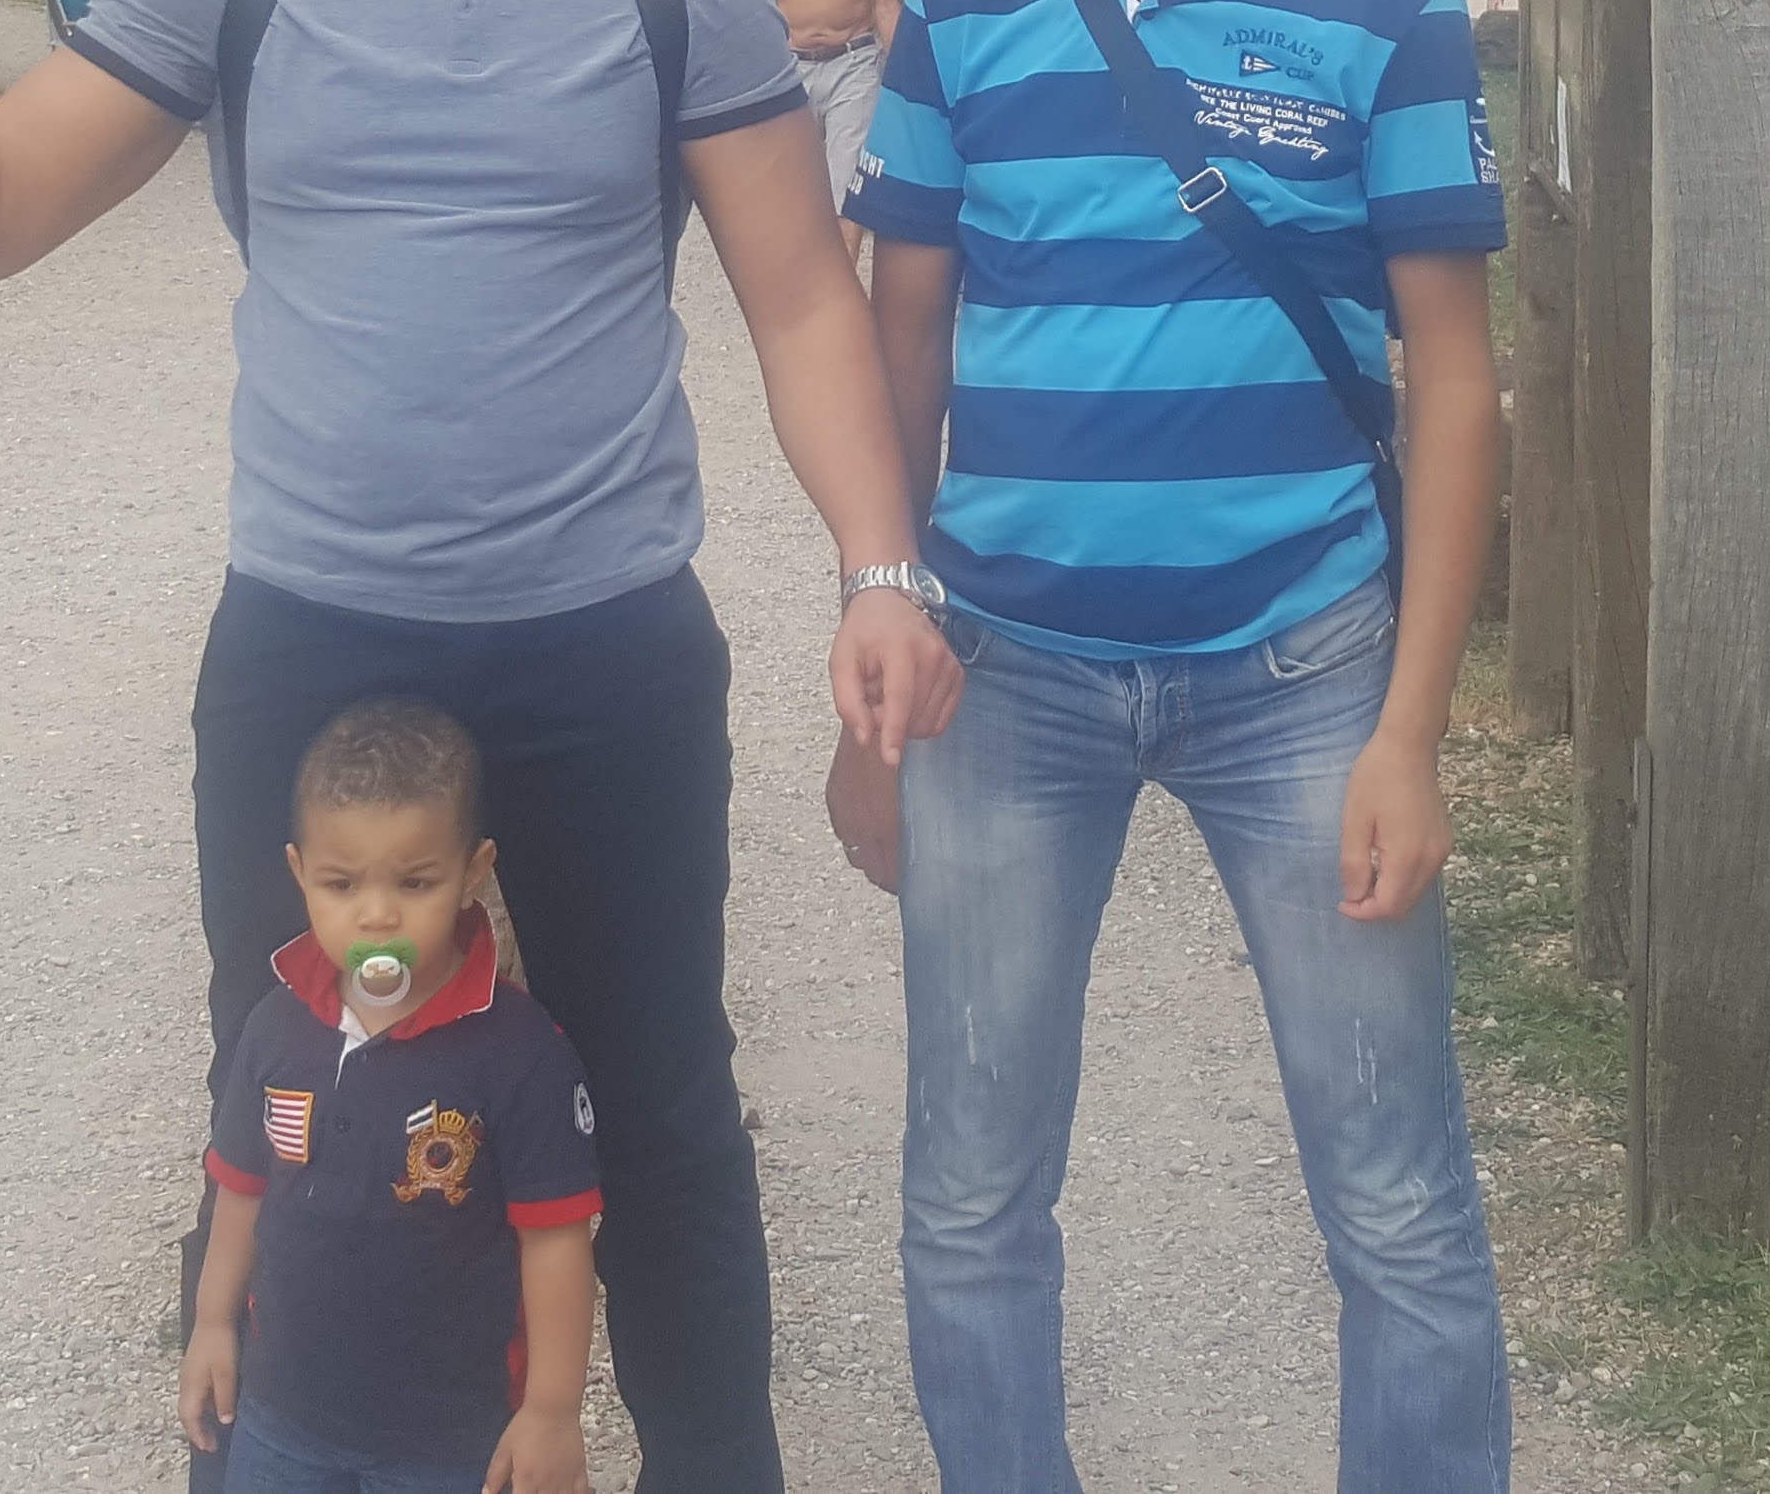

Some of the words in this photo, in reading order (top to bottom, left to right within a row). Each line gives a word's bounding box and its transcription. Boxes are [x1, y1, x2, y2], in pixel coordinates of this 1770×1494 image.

[1220, 99, 1238, 111] THE
[1240, 101, 1272, 116] LIVING
[1275, 108, 1304, 122] CORAL
[1306, 115, 1329, 127] REEF
[1272, 120, 1312, 135] Approved
